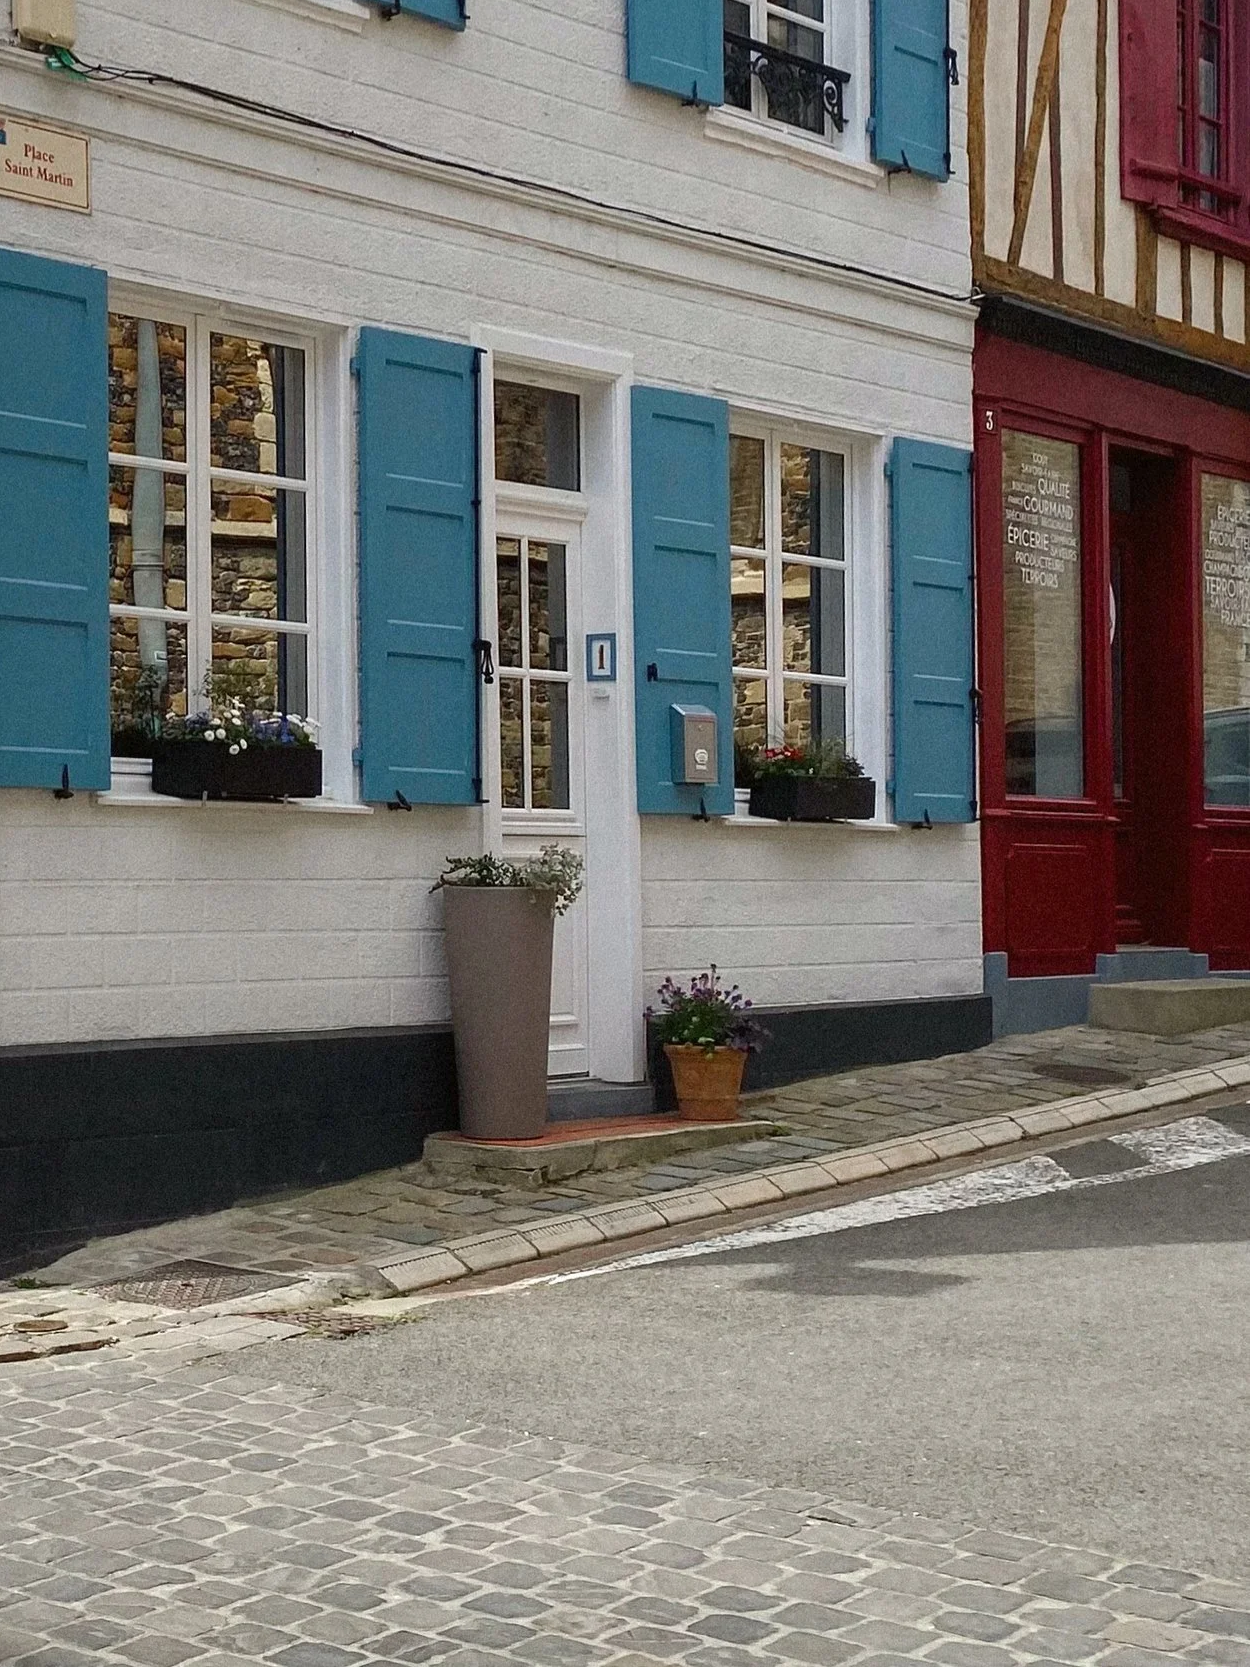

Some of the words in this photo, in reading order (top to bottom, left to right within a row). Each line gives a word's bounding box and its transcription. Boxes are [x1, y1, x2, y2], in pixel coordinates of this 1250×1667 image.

[24, 143, 54, 163] Place
[5, 159, 33, 178] Saint
[36, 166, 73, 187] Martin
[986, 410, 993, 431] 3
[1038, 478, 1071, 499] QUALITÉ
[1023, 495, 1074, 521] GOURMAND
[1007, 522, 1049, 551] ÉPICERIE
[1015, 550, 1065, 573] PRODUCTEURS
[1020, 566, 1058, 588] TERROIRS
[597, 644, 606, 670] 1
